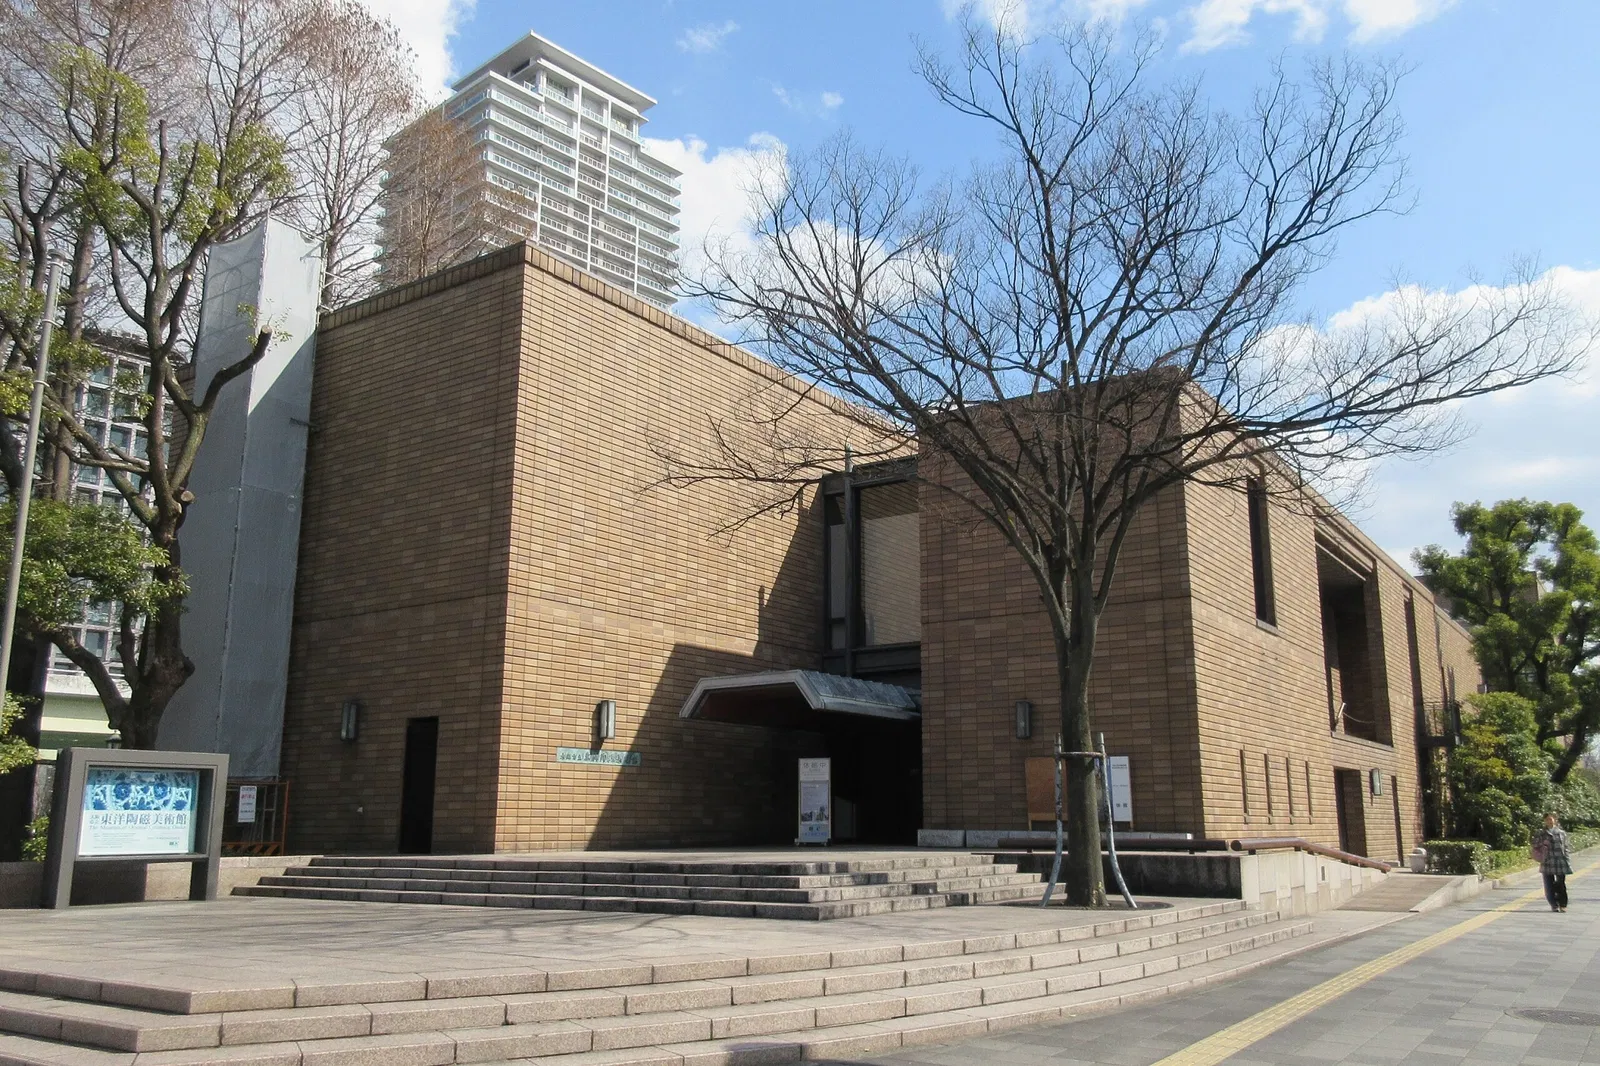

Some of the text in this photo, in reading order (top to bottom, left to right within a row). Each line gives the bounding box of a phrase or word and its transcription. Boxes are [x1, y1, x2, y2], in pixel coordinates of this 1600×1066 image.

[101, 813, 187, 825] 東洋陶磁美術館
